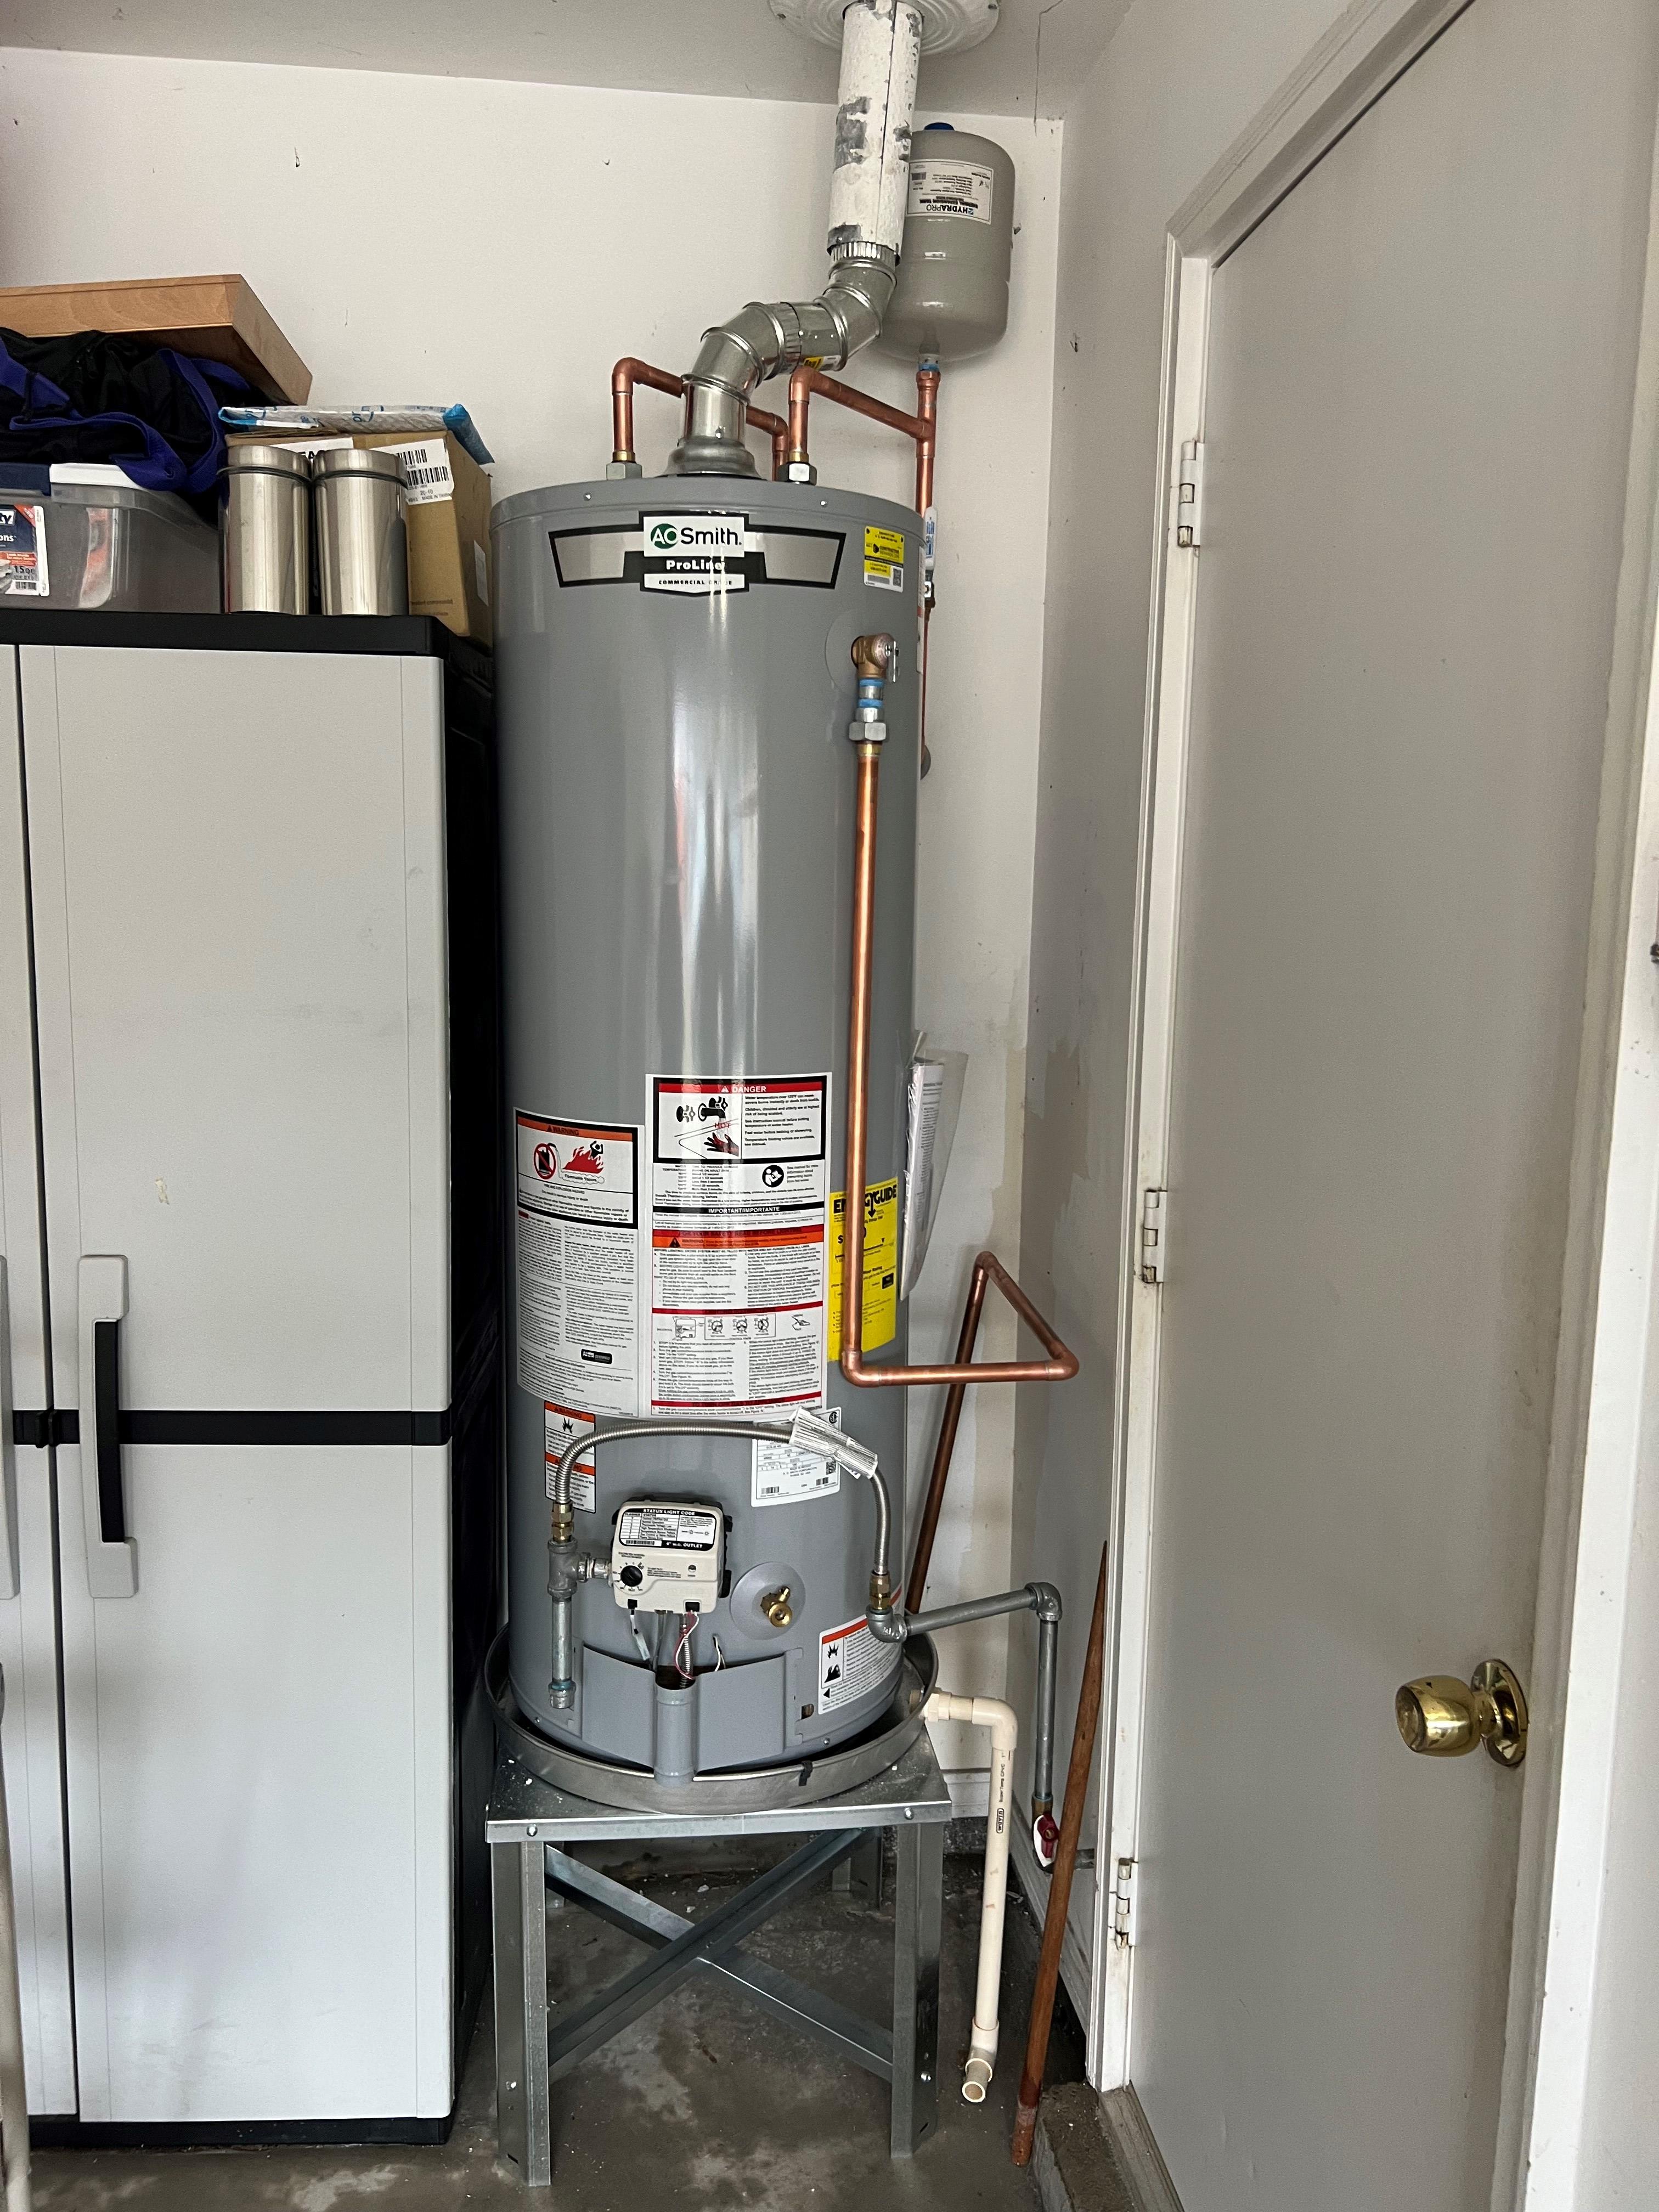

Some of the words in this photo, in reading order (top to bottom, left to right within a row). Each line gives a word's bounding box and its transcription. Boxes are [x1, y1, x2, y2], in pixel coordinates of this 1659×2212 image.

[926, 204, 968, 214] HYDRAPRO
[681, 527, 738, 545] Smith
[666, 559, 725, 571] ProLine
[834, 1184, 897, 1214] EGYGUIDE
